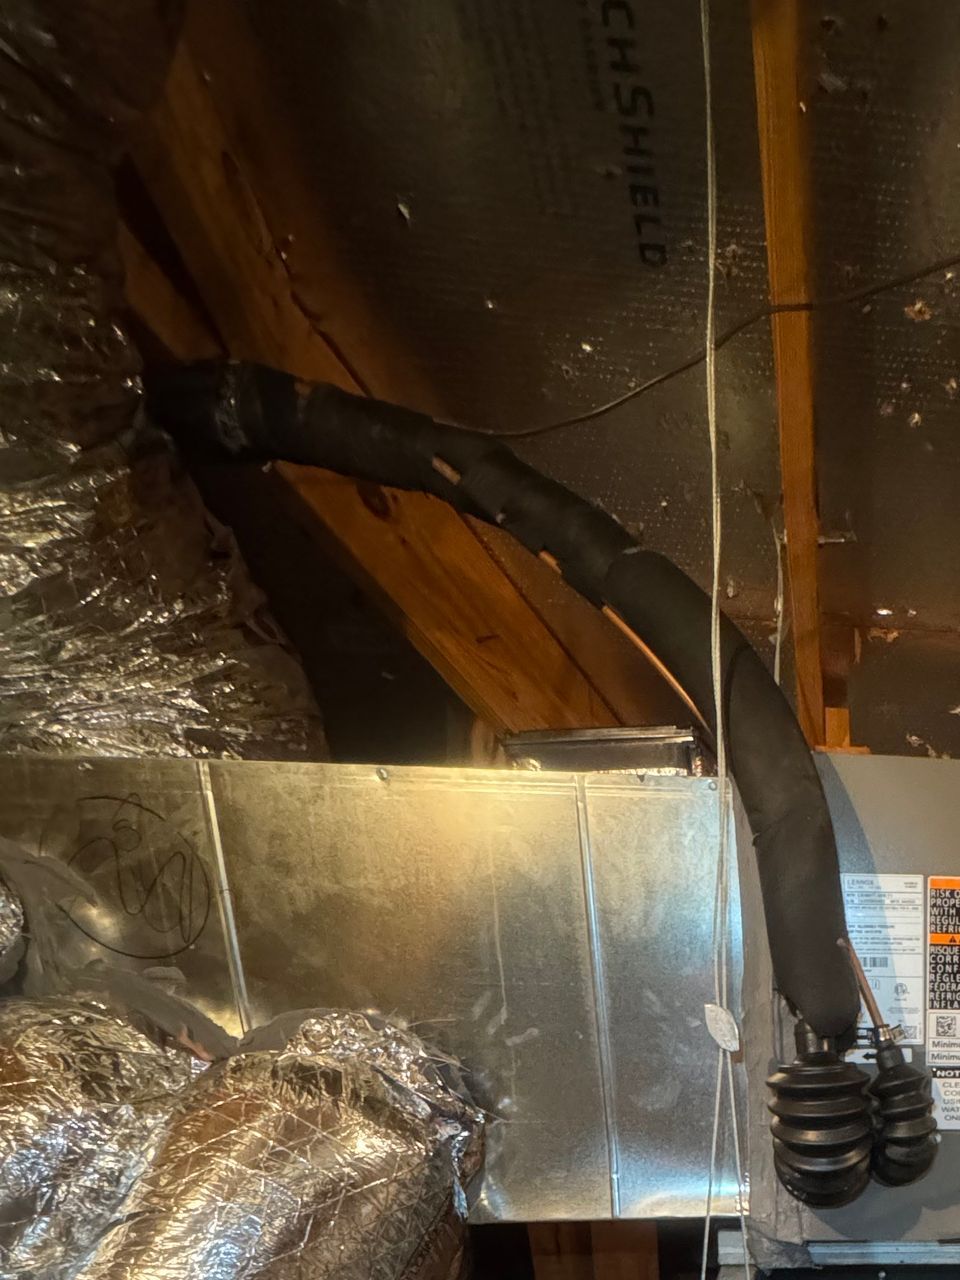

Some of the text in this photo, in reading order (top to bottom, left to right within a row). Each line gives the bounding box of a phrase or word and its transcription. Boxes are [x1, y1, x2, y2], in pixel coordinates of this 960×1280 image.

[931, 889, 951, 898] RISK
[931, 908, 956, 916] WITH
[931, 946, 959, 955] RISQUE
